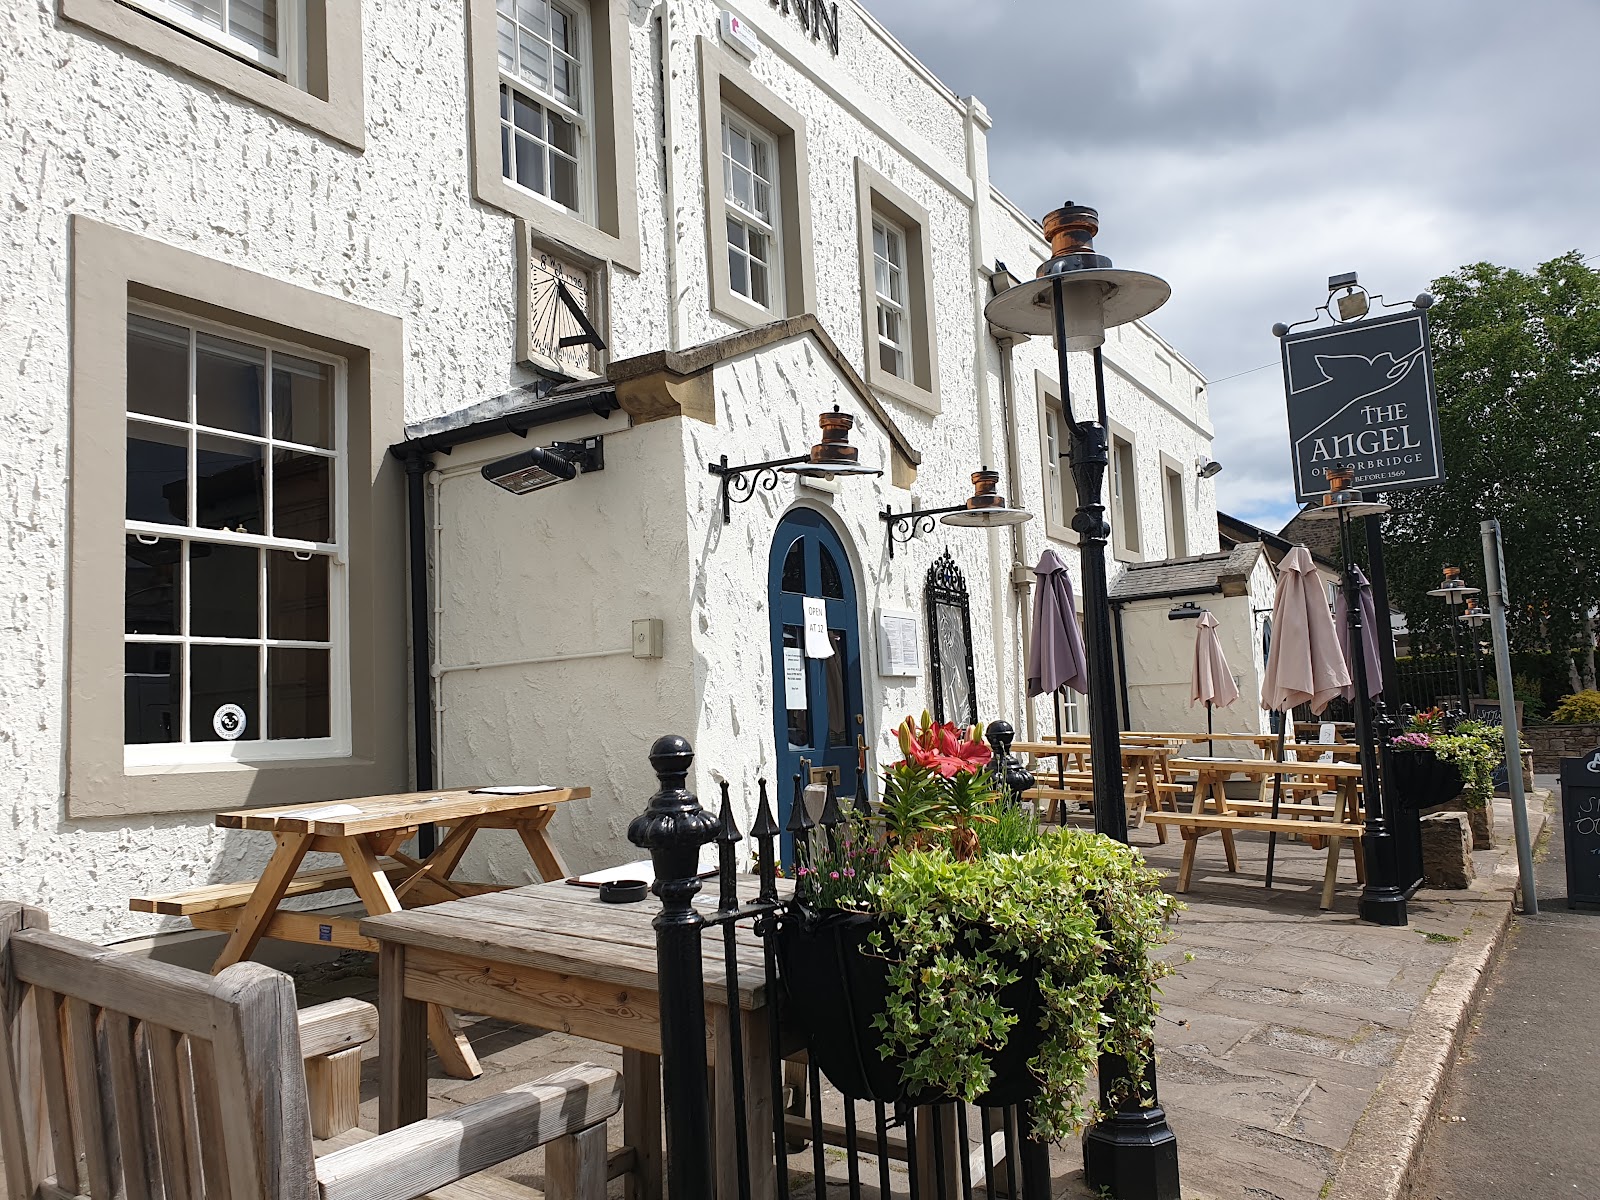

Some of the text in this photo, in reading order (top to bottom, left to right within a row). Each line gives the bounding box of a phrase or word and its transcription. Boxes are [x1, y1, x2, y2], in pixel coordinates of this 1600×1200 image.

[1360, 402, 1408, 426] THE
[1310, 424, 1421, 463] ANGEL
[1340, 453, 1423, 471] ORBRIDGE
[1355, 469, 1406, 483] BEFORE 1569
[808, 606, 823, 616] OPEN
[809, 623, 824, 633] AT 12
